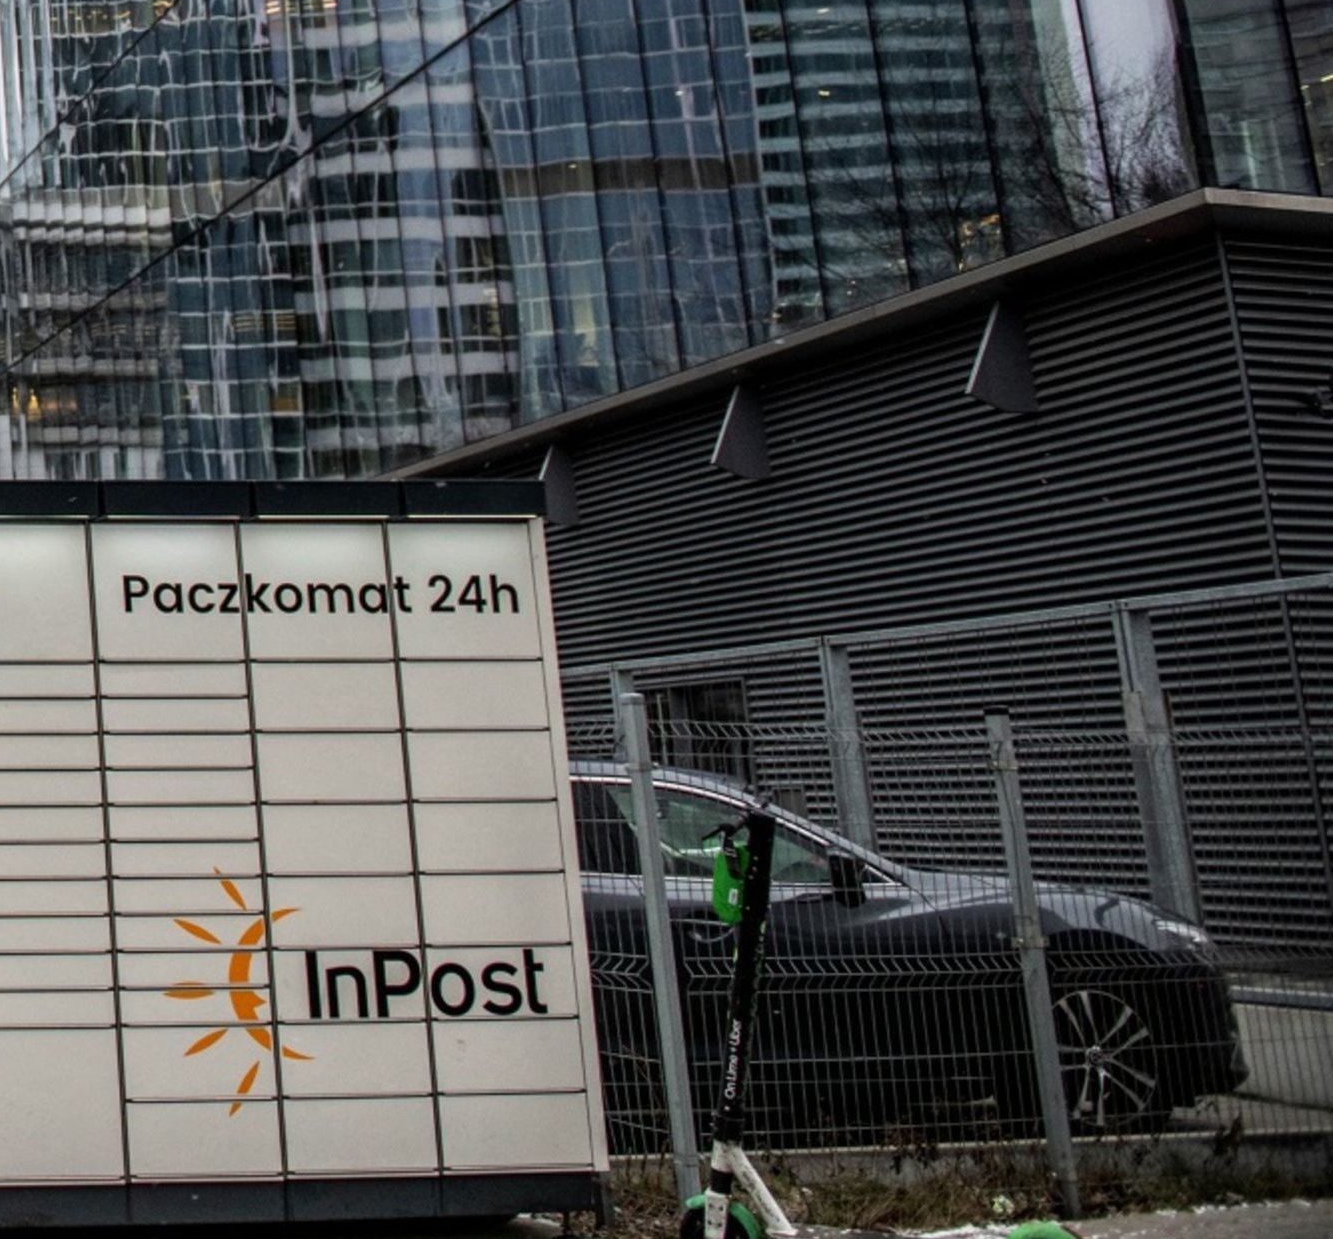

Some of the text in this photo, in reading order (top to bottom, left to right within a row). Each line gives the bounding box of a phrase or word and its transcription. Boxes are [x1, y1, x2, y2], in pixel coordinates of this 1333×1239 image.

[122, 573, 520, 615] Paczkomat 24h
[305, 948, 549, 1019] InPost
